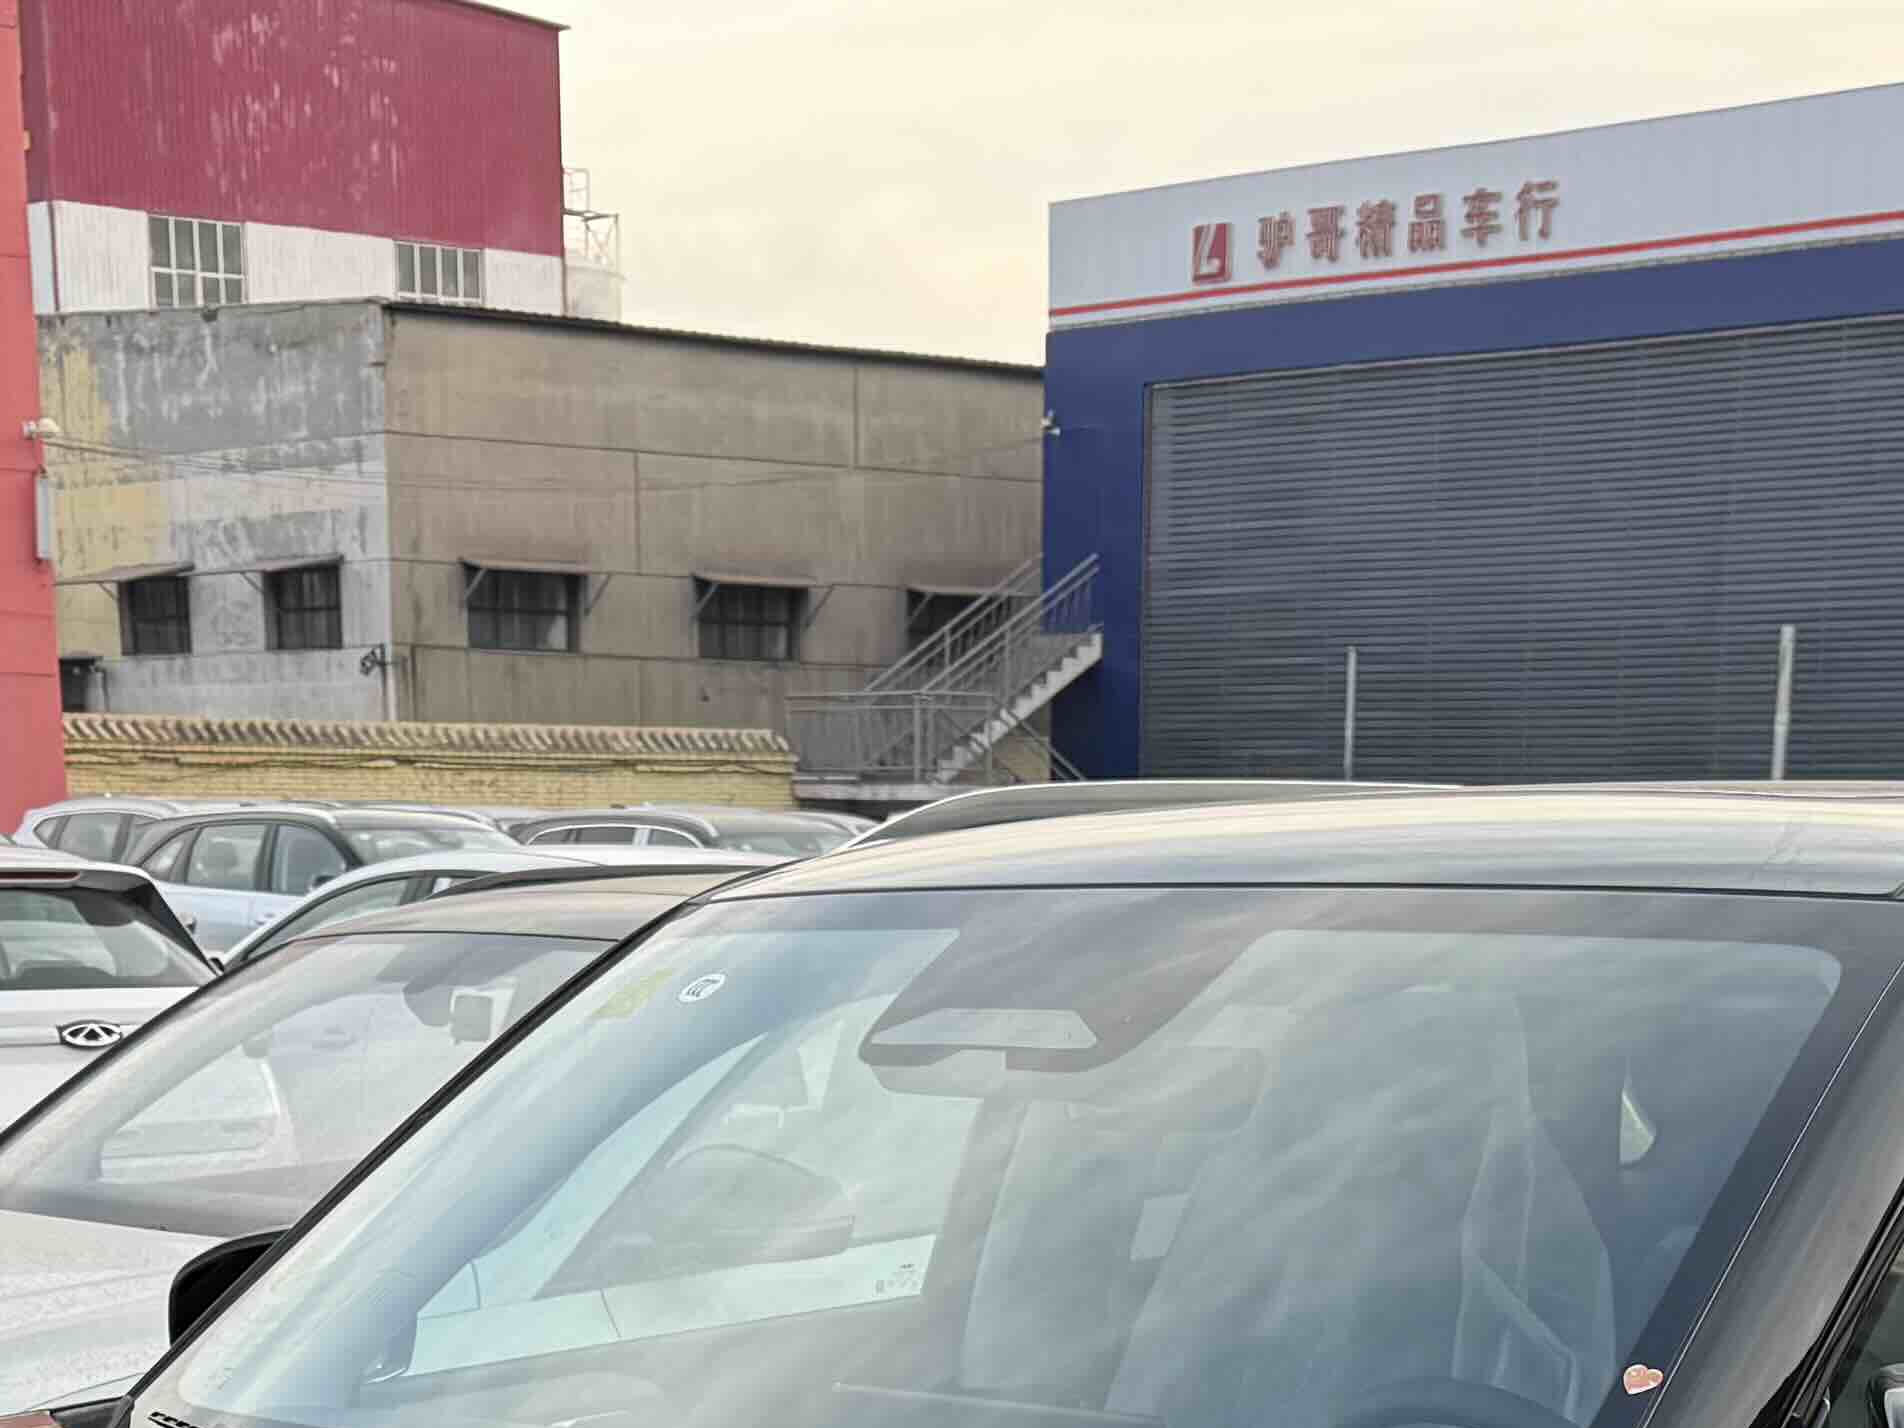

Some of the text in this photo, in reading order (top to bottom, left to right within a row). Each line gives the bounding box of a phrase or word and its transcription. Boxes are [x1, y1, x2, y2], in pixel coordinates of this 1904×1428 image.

[1256, 180, 1559, 269] 驴哥精品车行
